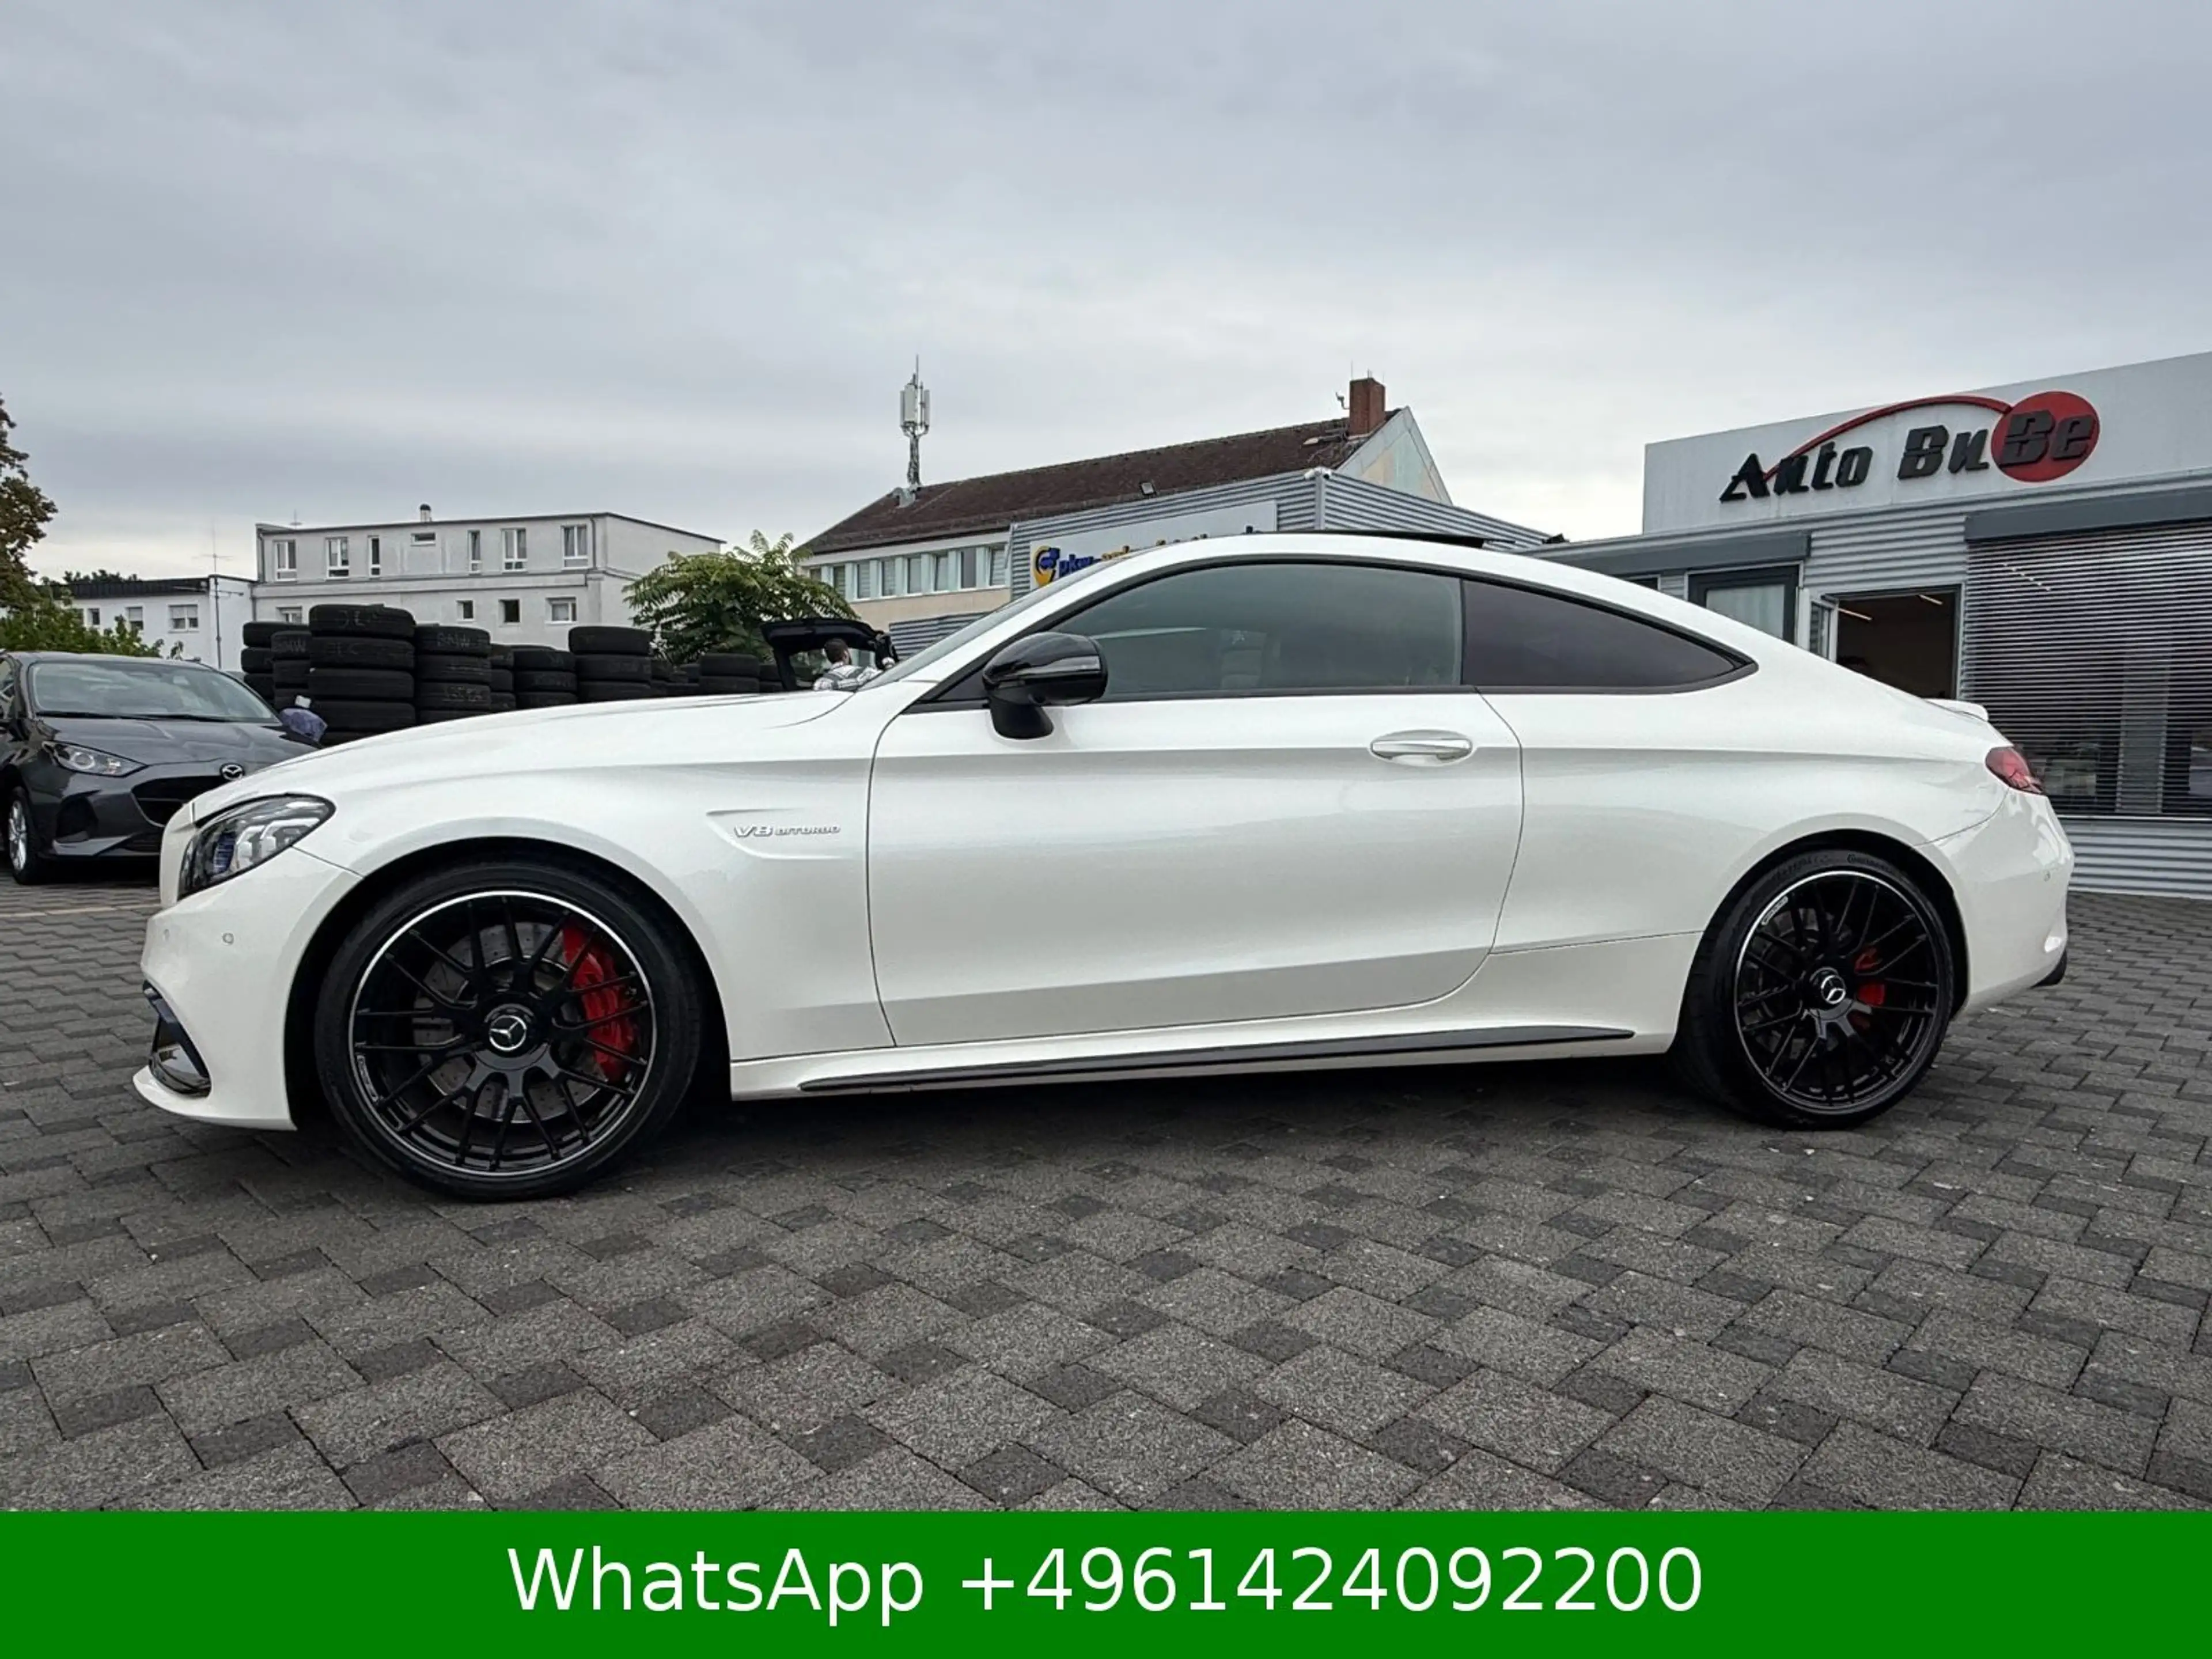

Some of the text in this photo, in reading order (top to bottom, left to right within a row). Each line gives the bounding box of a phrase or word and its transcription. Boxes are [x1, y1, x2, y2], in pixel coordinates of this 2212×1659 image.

[1719, 408, 2096, 503] Auto BuBe
[734, 824, 774, 838] V8
